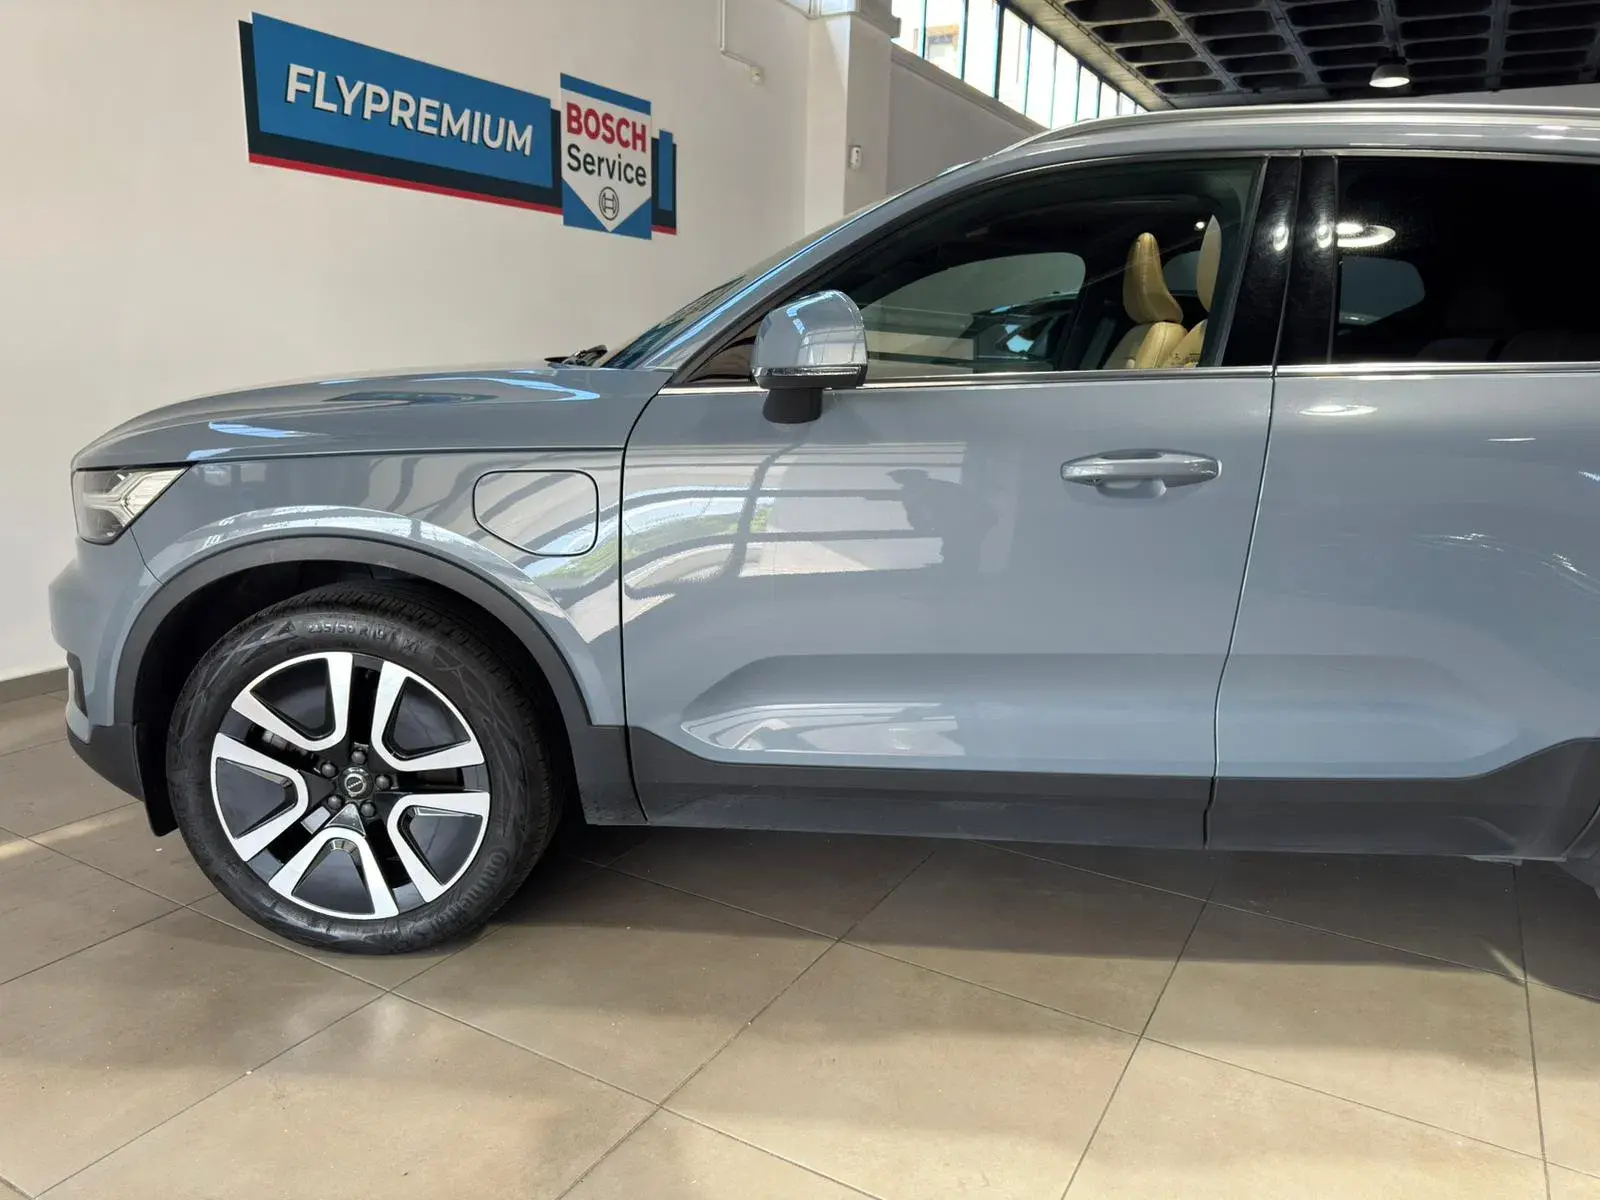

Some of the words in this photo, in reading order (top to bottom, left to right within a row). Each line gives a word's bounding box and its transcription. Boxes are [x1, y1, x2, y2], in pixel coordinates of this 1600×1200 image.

[285, 63, 534, 156] FLYPREMIUM
[566, 102, 647, 153] BOSCH
[566, 144, 647, 187] Service
